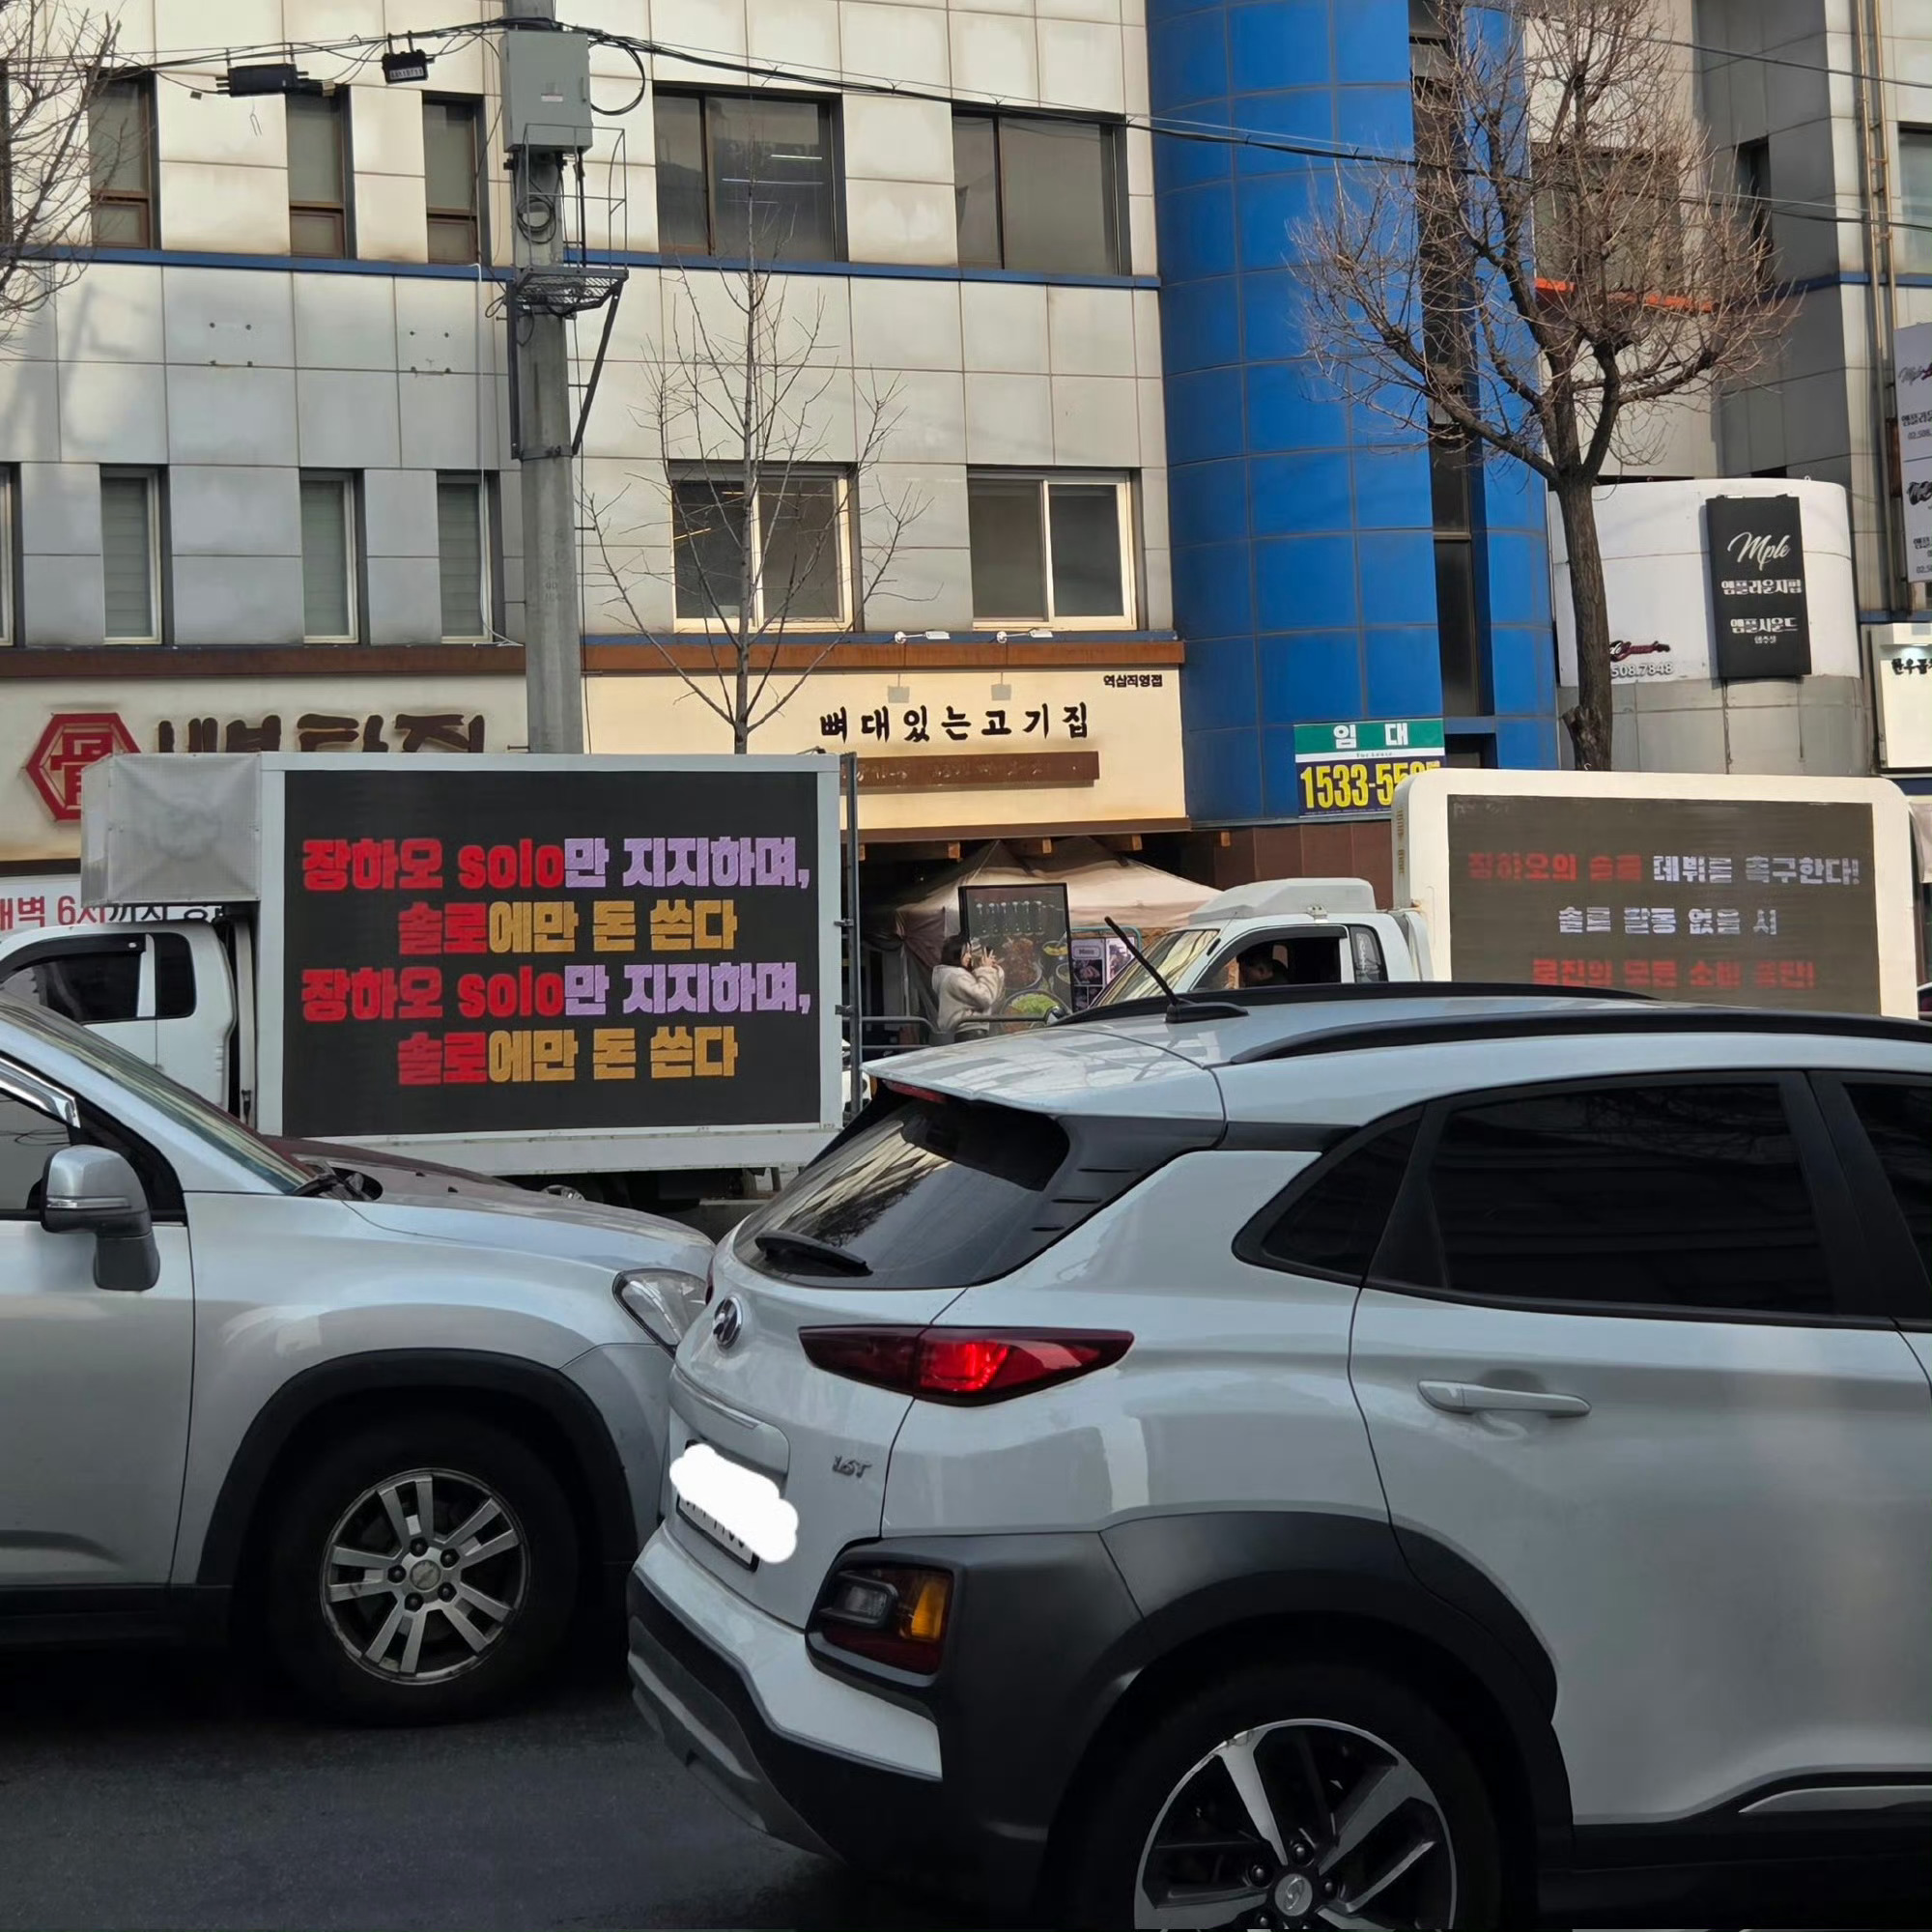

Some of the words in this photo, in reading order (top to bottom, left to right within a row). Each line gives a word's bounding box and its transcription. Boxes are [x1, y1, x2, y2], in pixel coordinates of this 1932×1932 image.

[1727, 531, 1790, 571] Mple
[1730, 617, 1799, 634] 엠플사운드
[1103, 673, 1163, 688] 역삼직영점
[302, 838, 444, 891] 장하오
[623, 837, 810, 890] 지지하며,
[1467, 852, 1577, 882] 장하오의
[1653, 856, 1732, 884] 데뷔를
[1746, 856, 1861, 885] 촉구한다!
[398, 900, 580, 955] 솔로에만
[592, 899, 637, 952] 돈
[650, 899, 738, 952] 쓴다
[1558, 906, 1611, 934] 솔로
[1688, 908, 1740, 935] 없을
[1752, 909, 1777, 935] 시
[301, 967, 444, 1022] 장하오
[623, 962, 811, 1015] 지지하며,
[398, 1029, 580, 1086] 솔로에만
[592, 1028, 637, 1081] 돈
[650, 1026, 739, 1079] 쓴다
